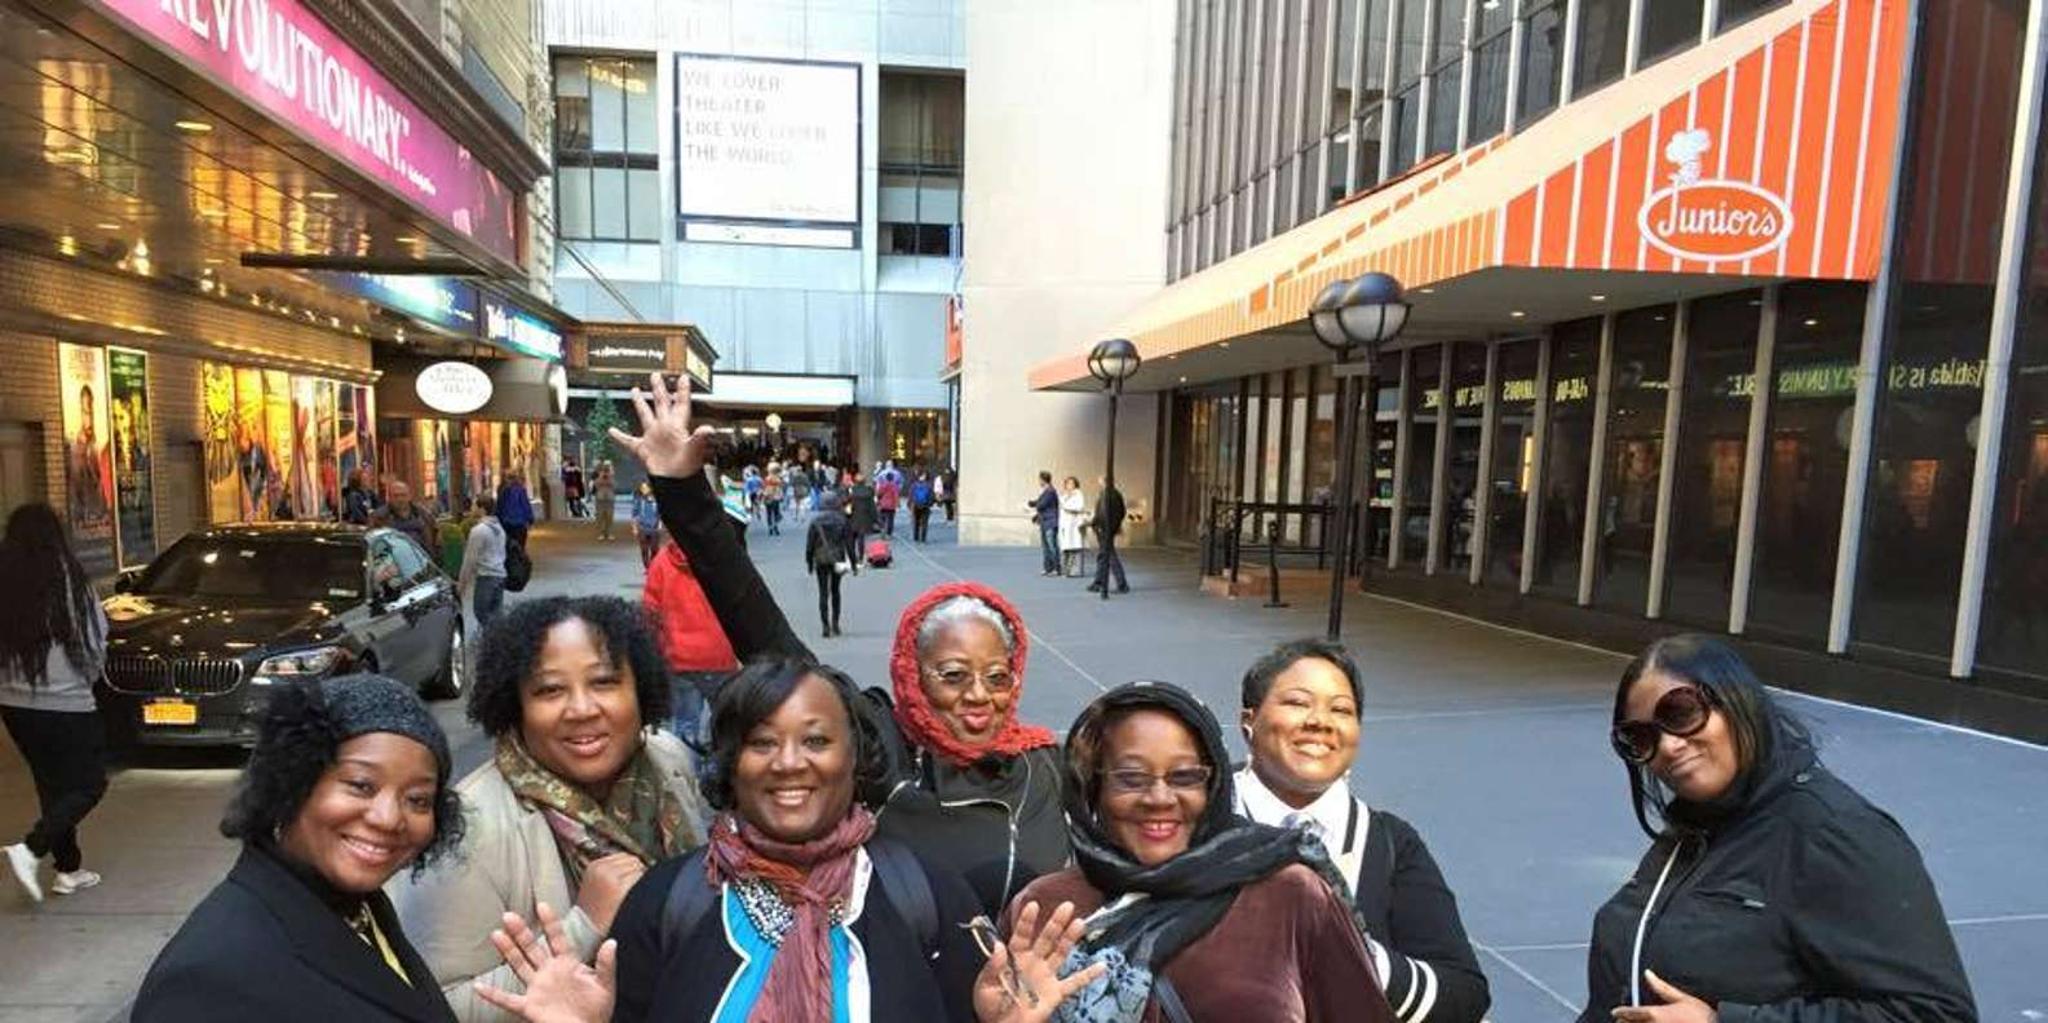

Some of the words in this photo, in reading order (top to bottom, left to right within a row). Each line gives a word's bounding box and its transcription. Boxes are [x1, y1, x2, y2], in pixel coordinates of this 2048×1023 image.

[685, 71, 711, 87] WE
[685, 121, 724, 138] LIKE
[731, 121, 762, 141] WE
[685, 144, 717, 162] THE
[1657, 190, 1778, 238] Junior's
